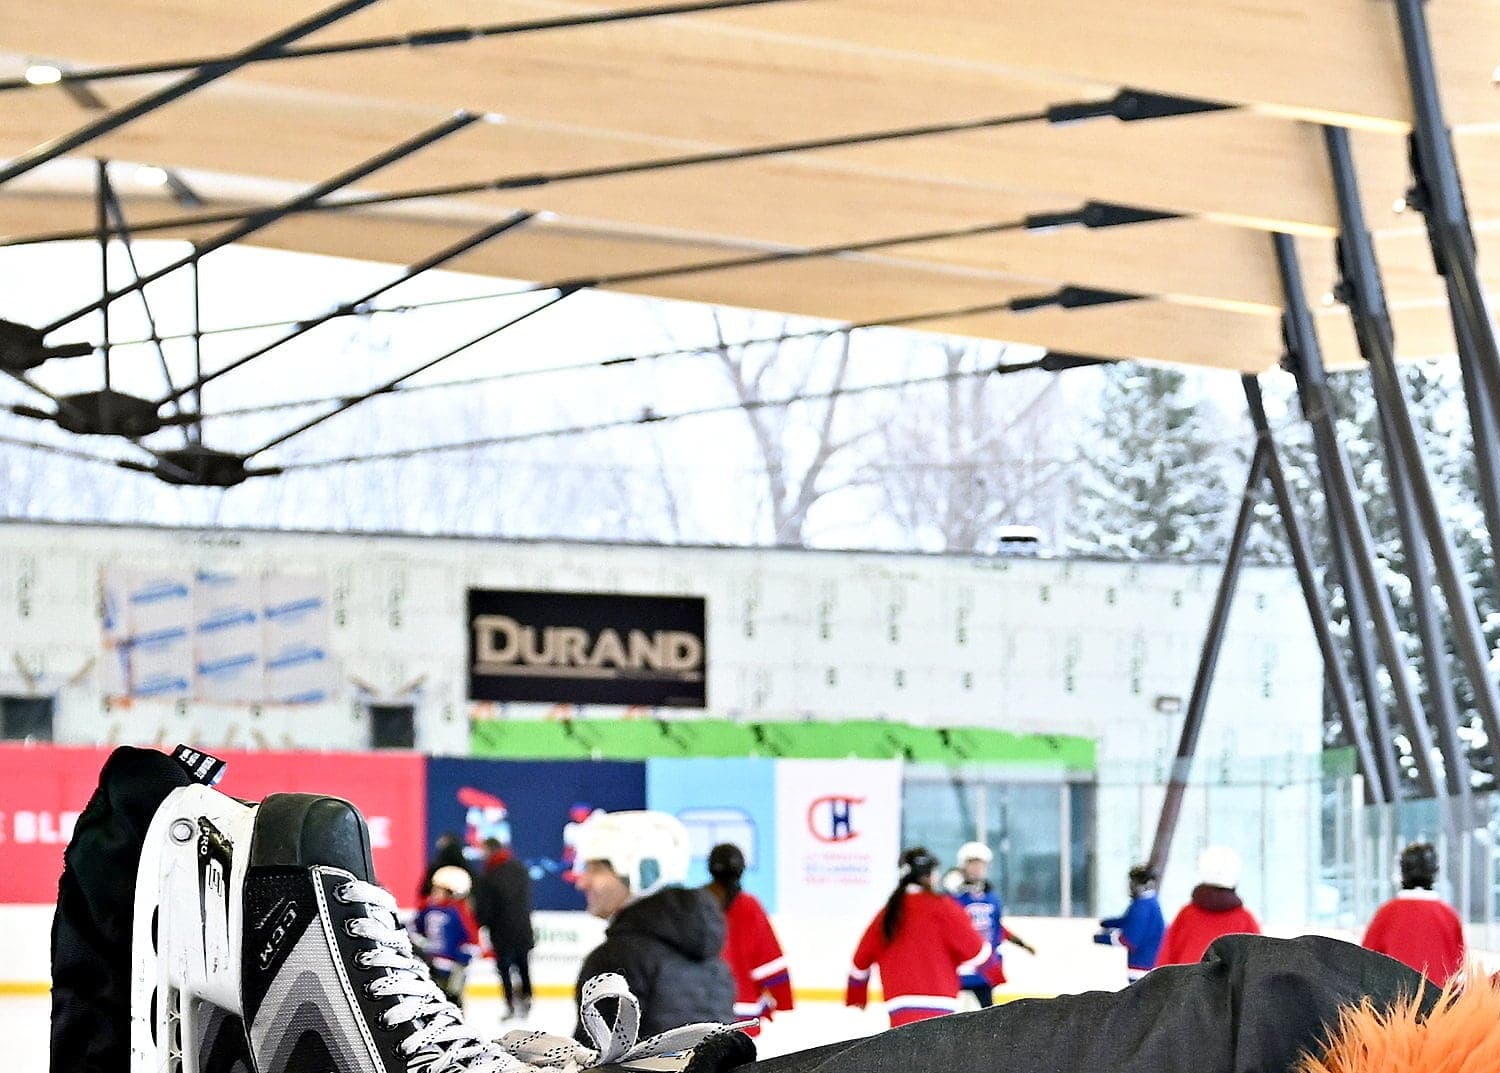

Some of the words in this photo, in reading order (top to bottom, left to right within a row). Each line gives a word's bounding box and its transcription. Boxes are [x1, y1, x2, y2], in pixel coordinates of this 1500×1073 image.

[473, 614, 701, 672] DURAND
[199, 826, 210, 856] PRO
[259, 908, 297, 962] CCM
